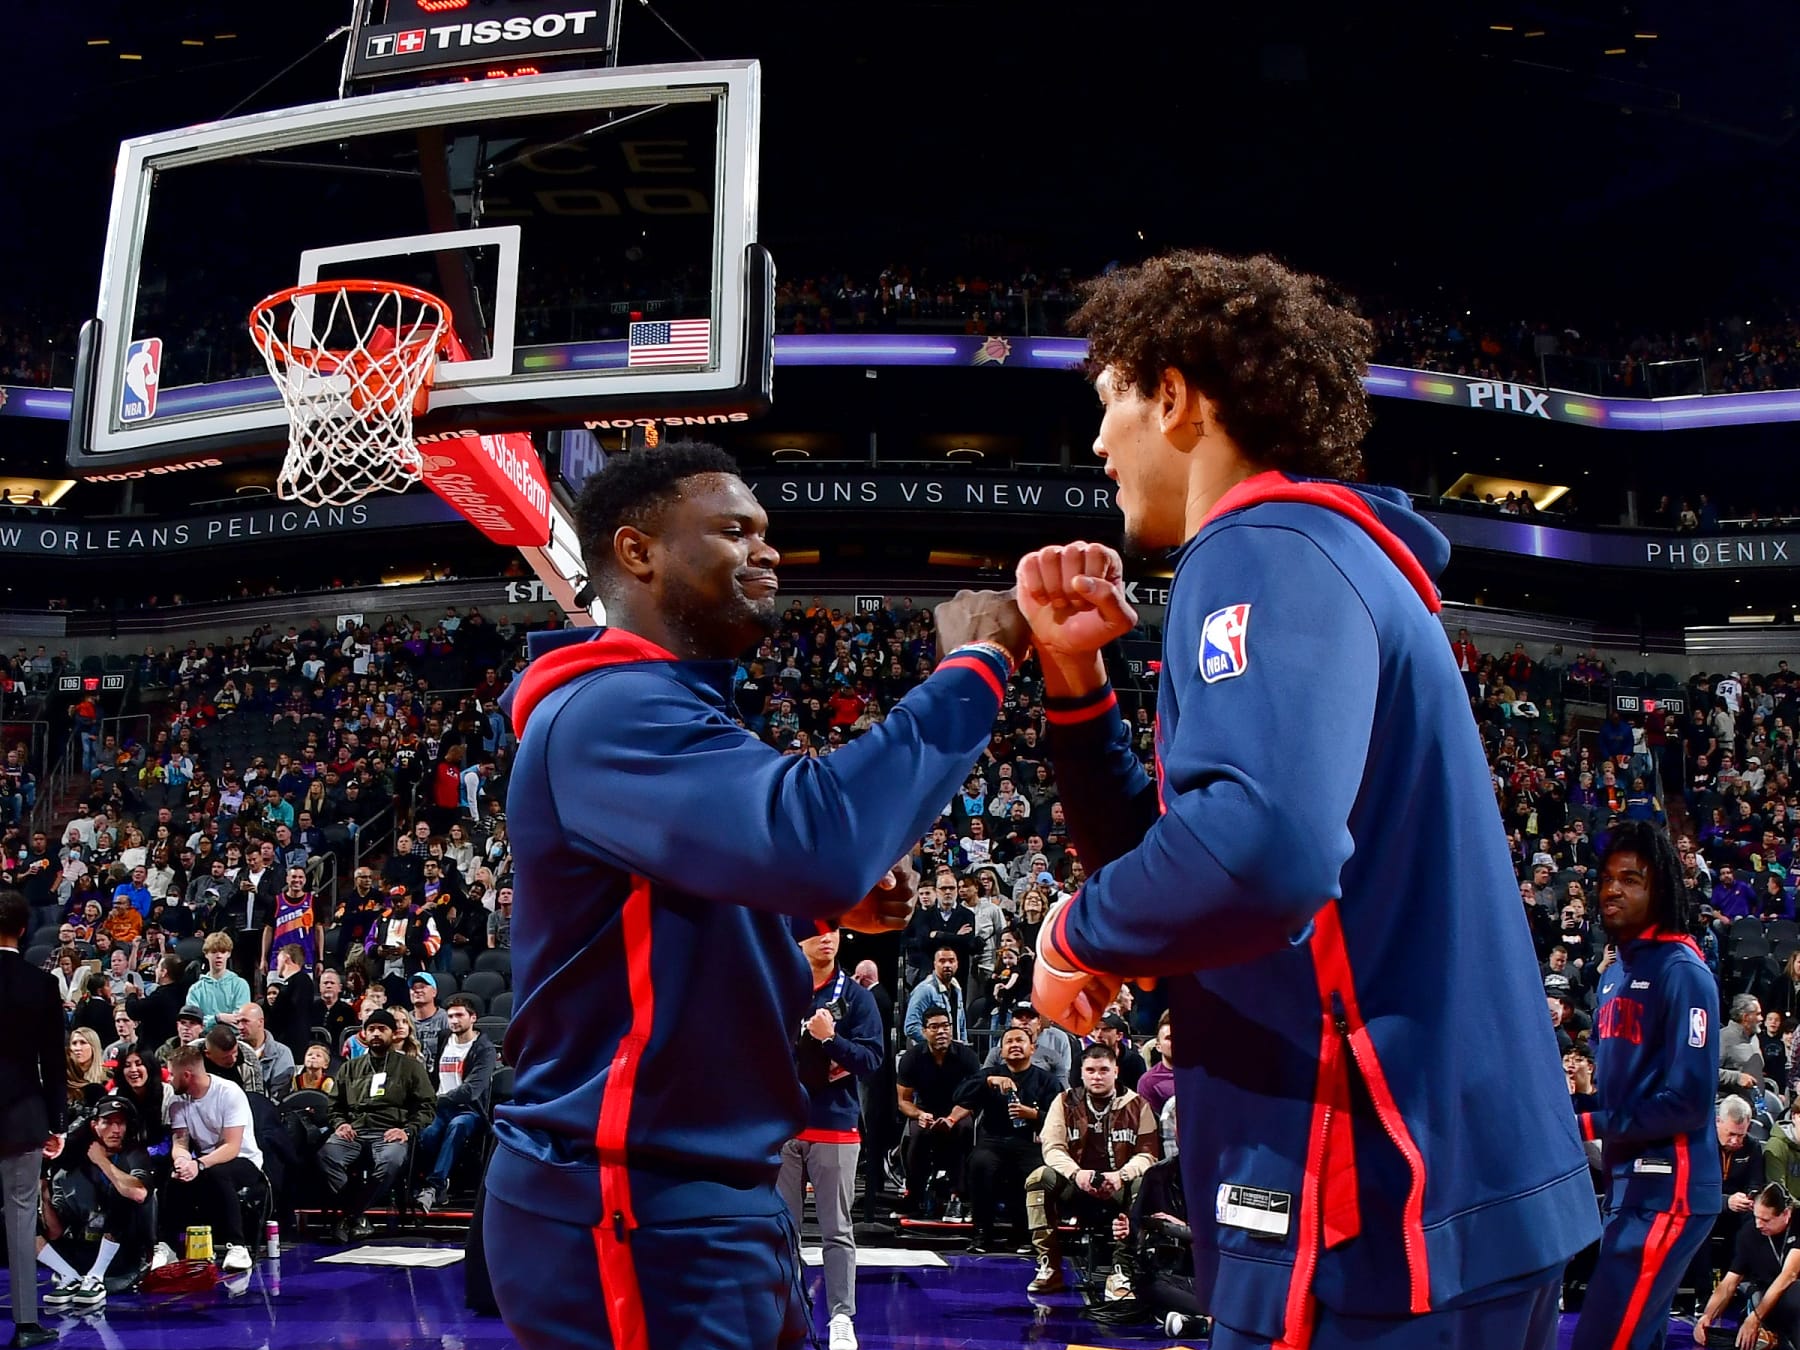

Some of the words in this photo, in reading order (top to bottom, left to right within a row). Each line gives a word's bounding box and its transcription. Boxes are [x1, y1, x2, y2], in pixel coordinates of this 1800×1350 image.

[428, 10, 597, 49] TISSOT
[125, 401, 143, 417] NBA
[1466, 383, 1551, 420] PHX
[583, 412, 749, 430] SUNS.COM
[84, 458, 223, 483] SUNS.COM
[781, 481, 878, 502] SUNS
[900, 481, 944, 503] VS
[966, 483, 1043, 506] NEW
[40, 524, 190, 551] ORLEANS
[207, 504, 367, 540] PELICANS
[1647, 540, 1789, 564] PHOENIX
[860, 599, 880, 612] 108
[1206, 653, 1229, 677] NBA
[63, 679, 78, 689] 106
[106, 677, 121, 687] 107
[1621, 698, 1636, 709] 109
[1666, 701, 1680, 712] 110
